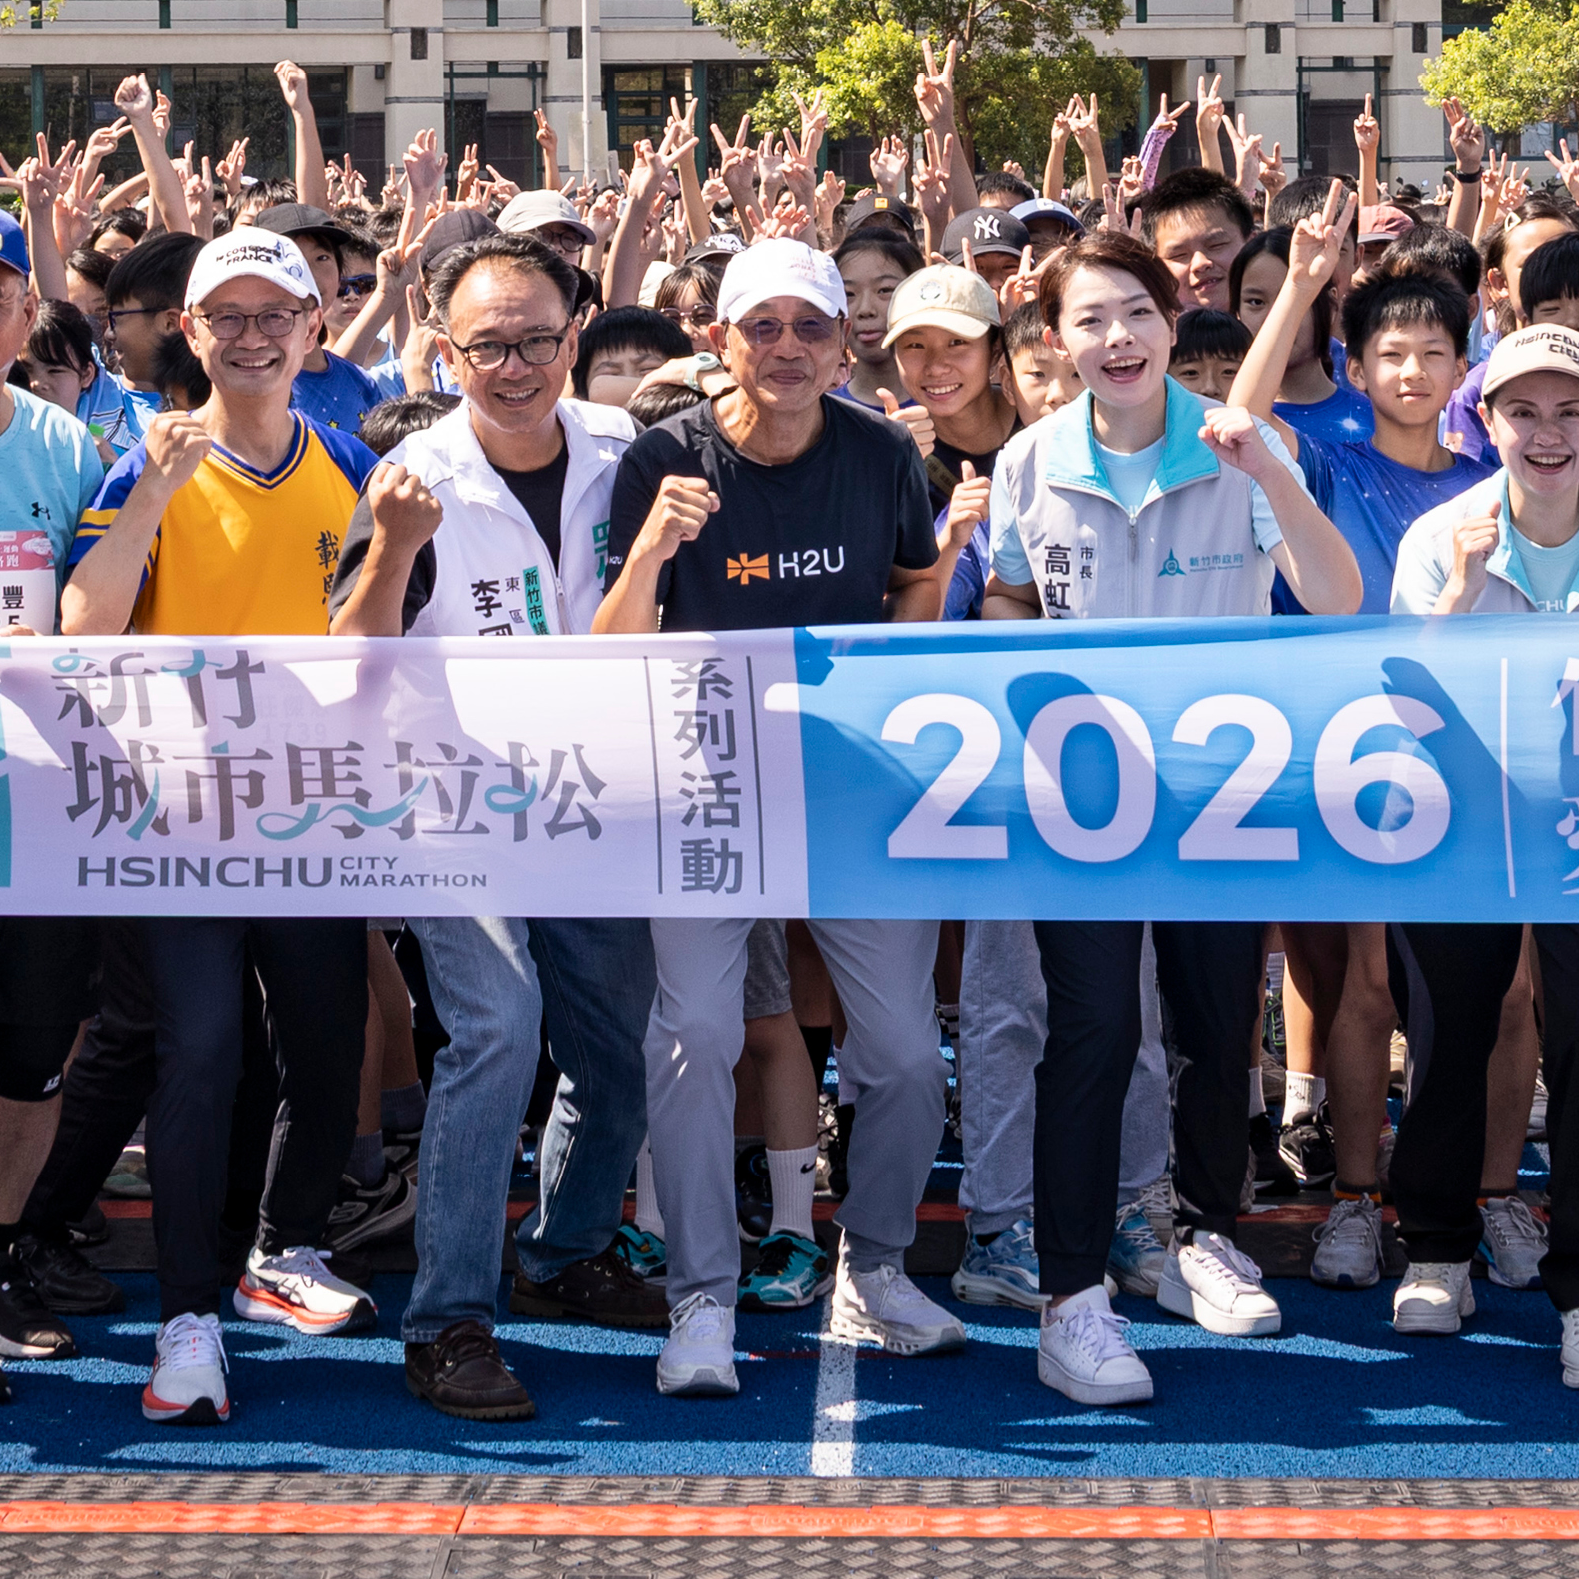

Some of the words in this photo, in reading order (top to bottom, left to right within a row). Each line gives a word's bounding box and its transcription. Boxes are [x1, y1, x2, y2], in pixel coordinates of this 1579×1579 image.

[973, 214, 1001, 240] NY
[778, 545, 845, 579] H2U
[1080, 546, 1095, 580] 市長
[1189, 553, 1244, 567] 新竹市政府
[1044, 544, 1072, 619] 高虹
[505, 576, 526, 624] 東區
[52, 649, 266, 729] 新竹
[62, 741, 608, 842] 城市馬拉松
[670, 657, 744, 895] 系列活動
[880, 693, 1452, 865] 2026
[77, 856, 333, 888] HSINCHU
[340, 856, 399, 871] CITY
[340, 873, 488, 888] MARATHON
